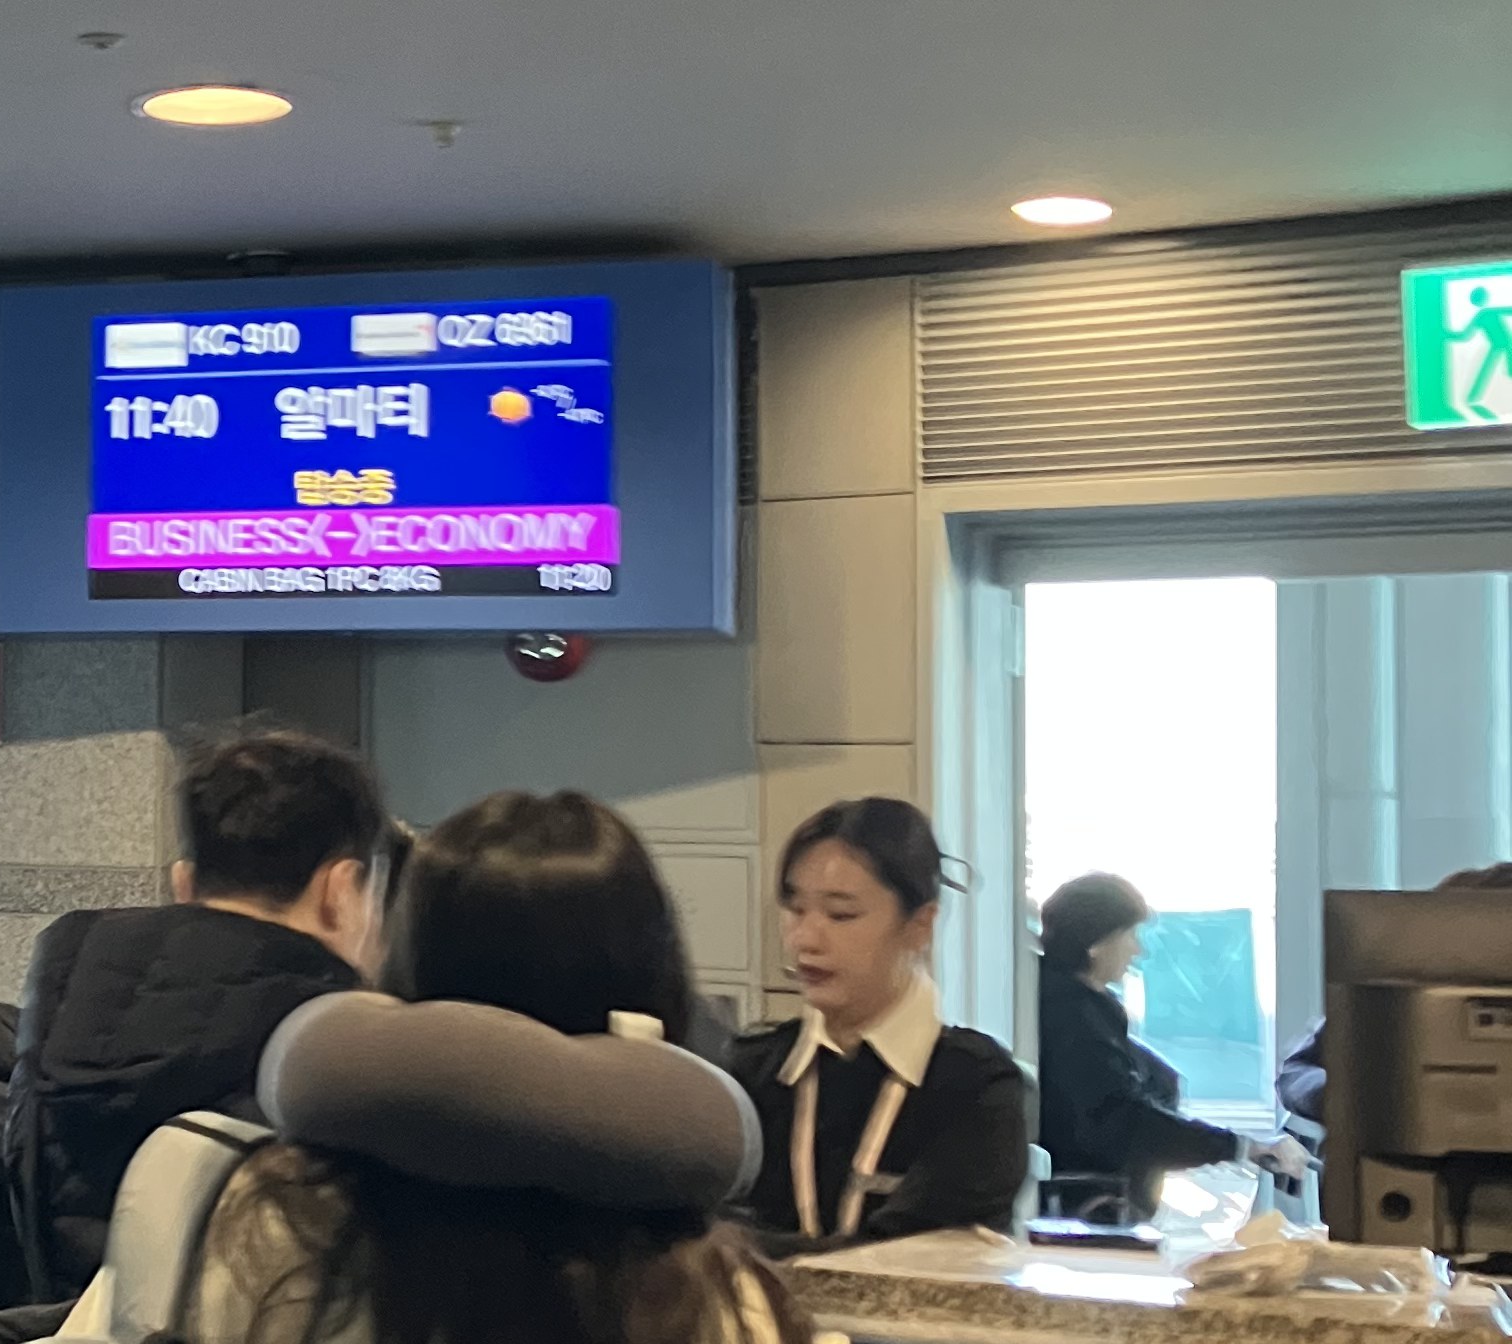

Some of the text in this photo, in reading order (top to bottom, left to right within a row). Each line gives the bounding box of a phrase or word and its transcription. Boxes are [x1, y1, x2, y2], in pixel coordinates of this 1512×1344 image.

[438, 313, 497, 348] OZ
[104, 383, 430, 440] 11:40 알마티
